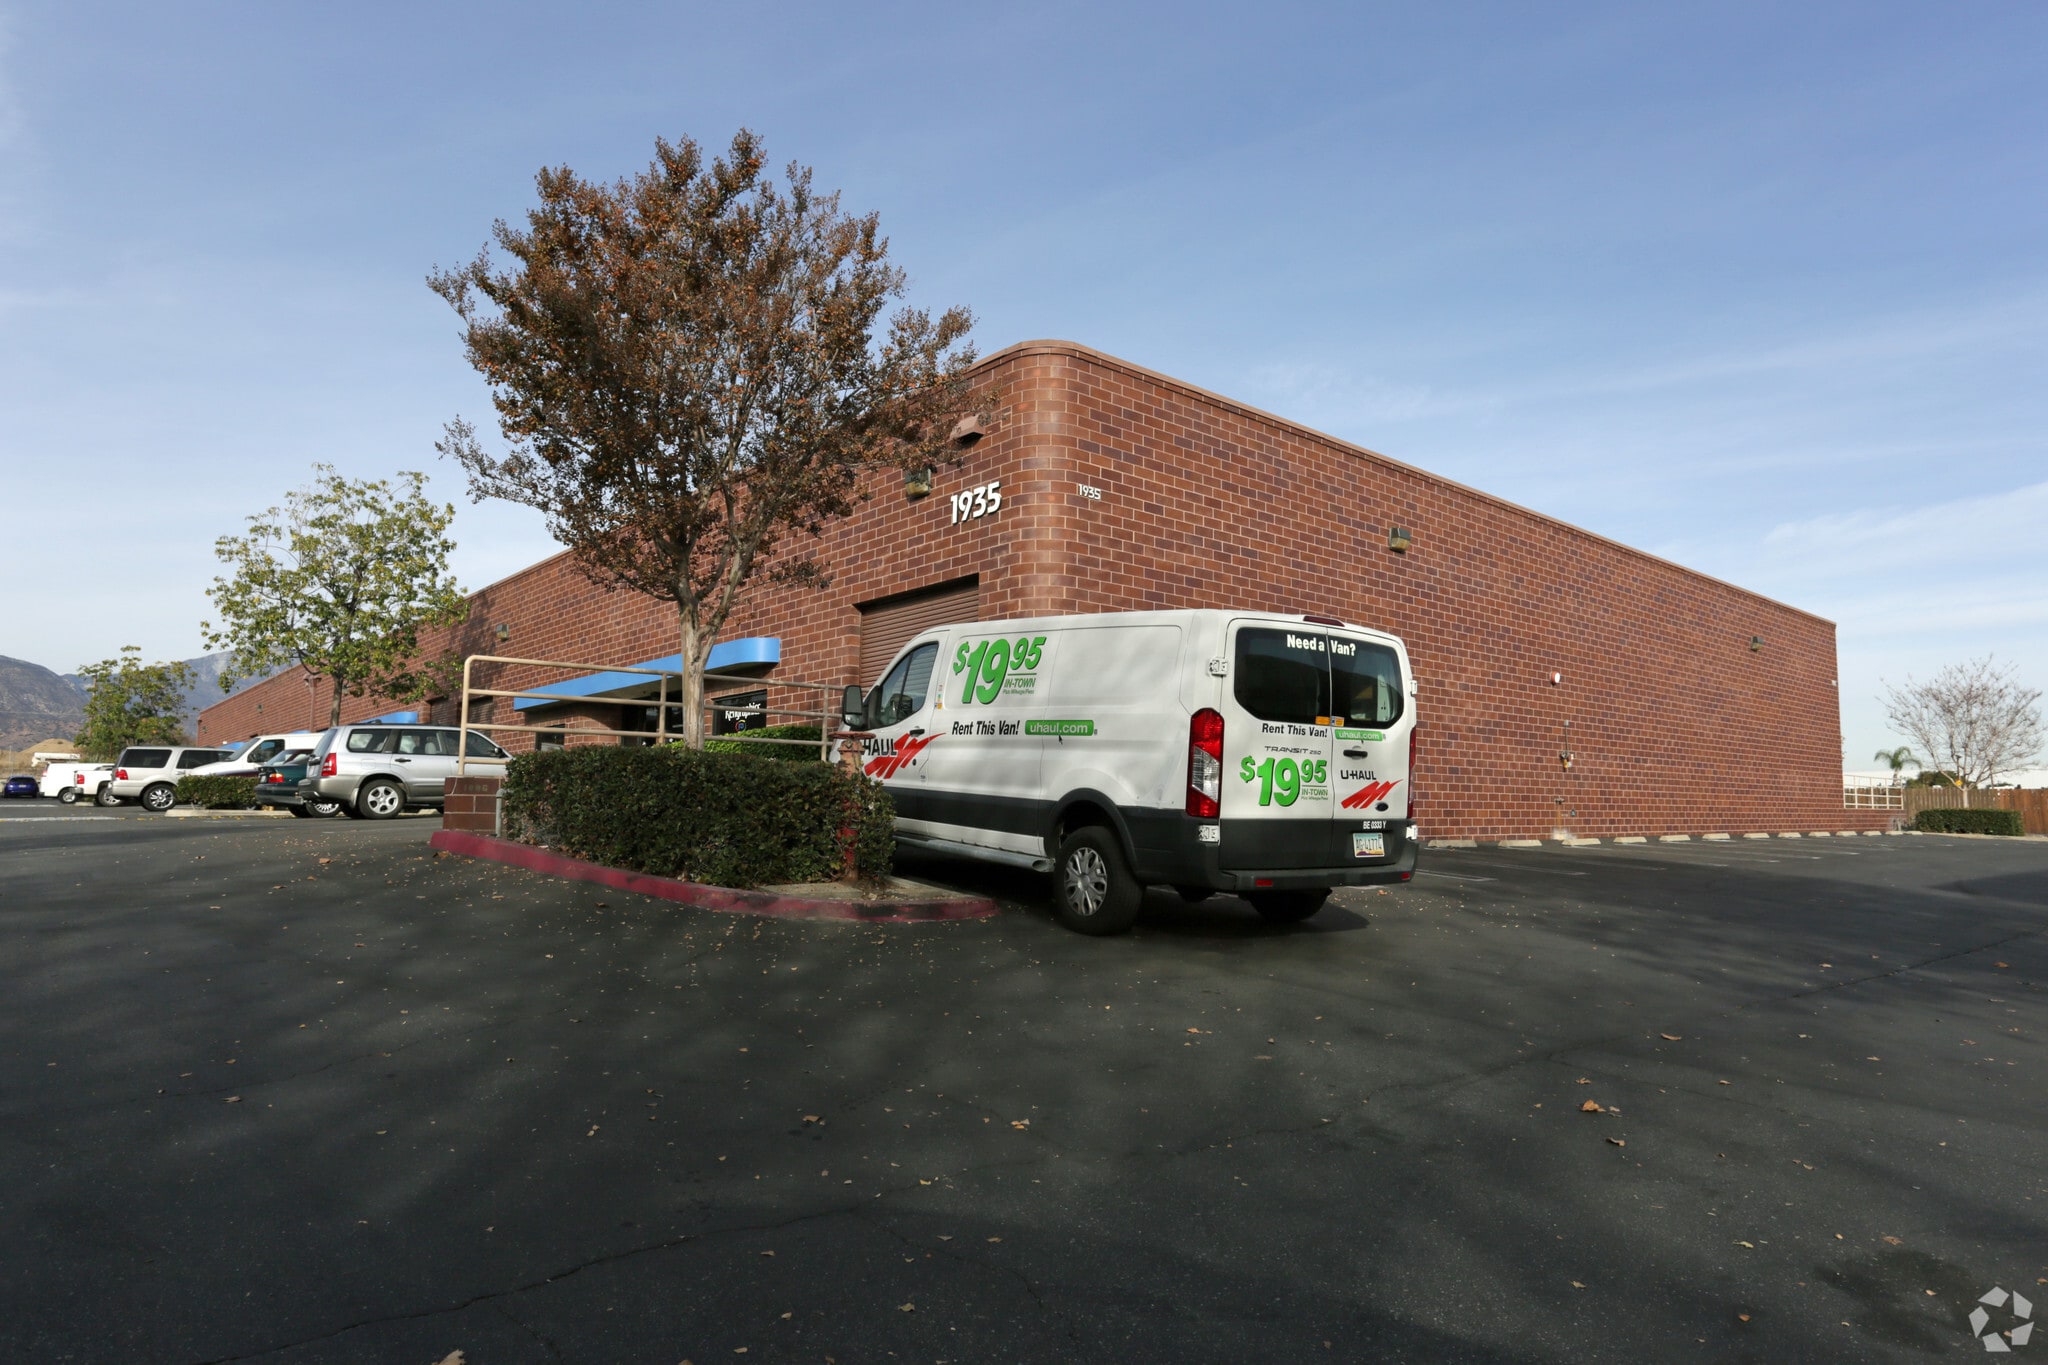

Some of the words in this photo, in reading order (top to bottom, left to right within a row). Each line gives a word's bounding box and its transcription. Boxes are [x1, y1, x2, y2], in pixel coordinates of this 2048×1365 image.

[1078, 484, 1101, 500] 1935
[950, 481, 1002, 525] 1935
[1287, 634, 1317, 651] Need
[1318, 641, 1325, 652] a
[1330, 640, 1356, 656] Van?
[1004, 677, 1036, 688] IN-TOWN
[952, 721, 973, 735] Rent
[976, 720, 995, 735] This
[999, 720, 1020, 735] Van!
[1030, 722, 1088, 733] uhaul.com
[1262, 723, 1284, 734] Rent
[1287, 724, 1306, 736] This
[1309, 727, 1328, 738] Van!
[1338, 731, 1380, 740] uhaul.com
[863, 738, 897, 756] HAUL
[1340, 769, 1377, 781] U-HAUL
